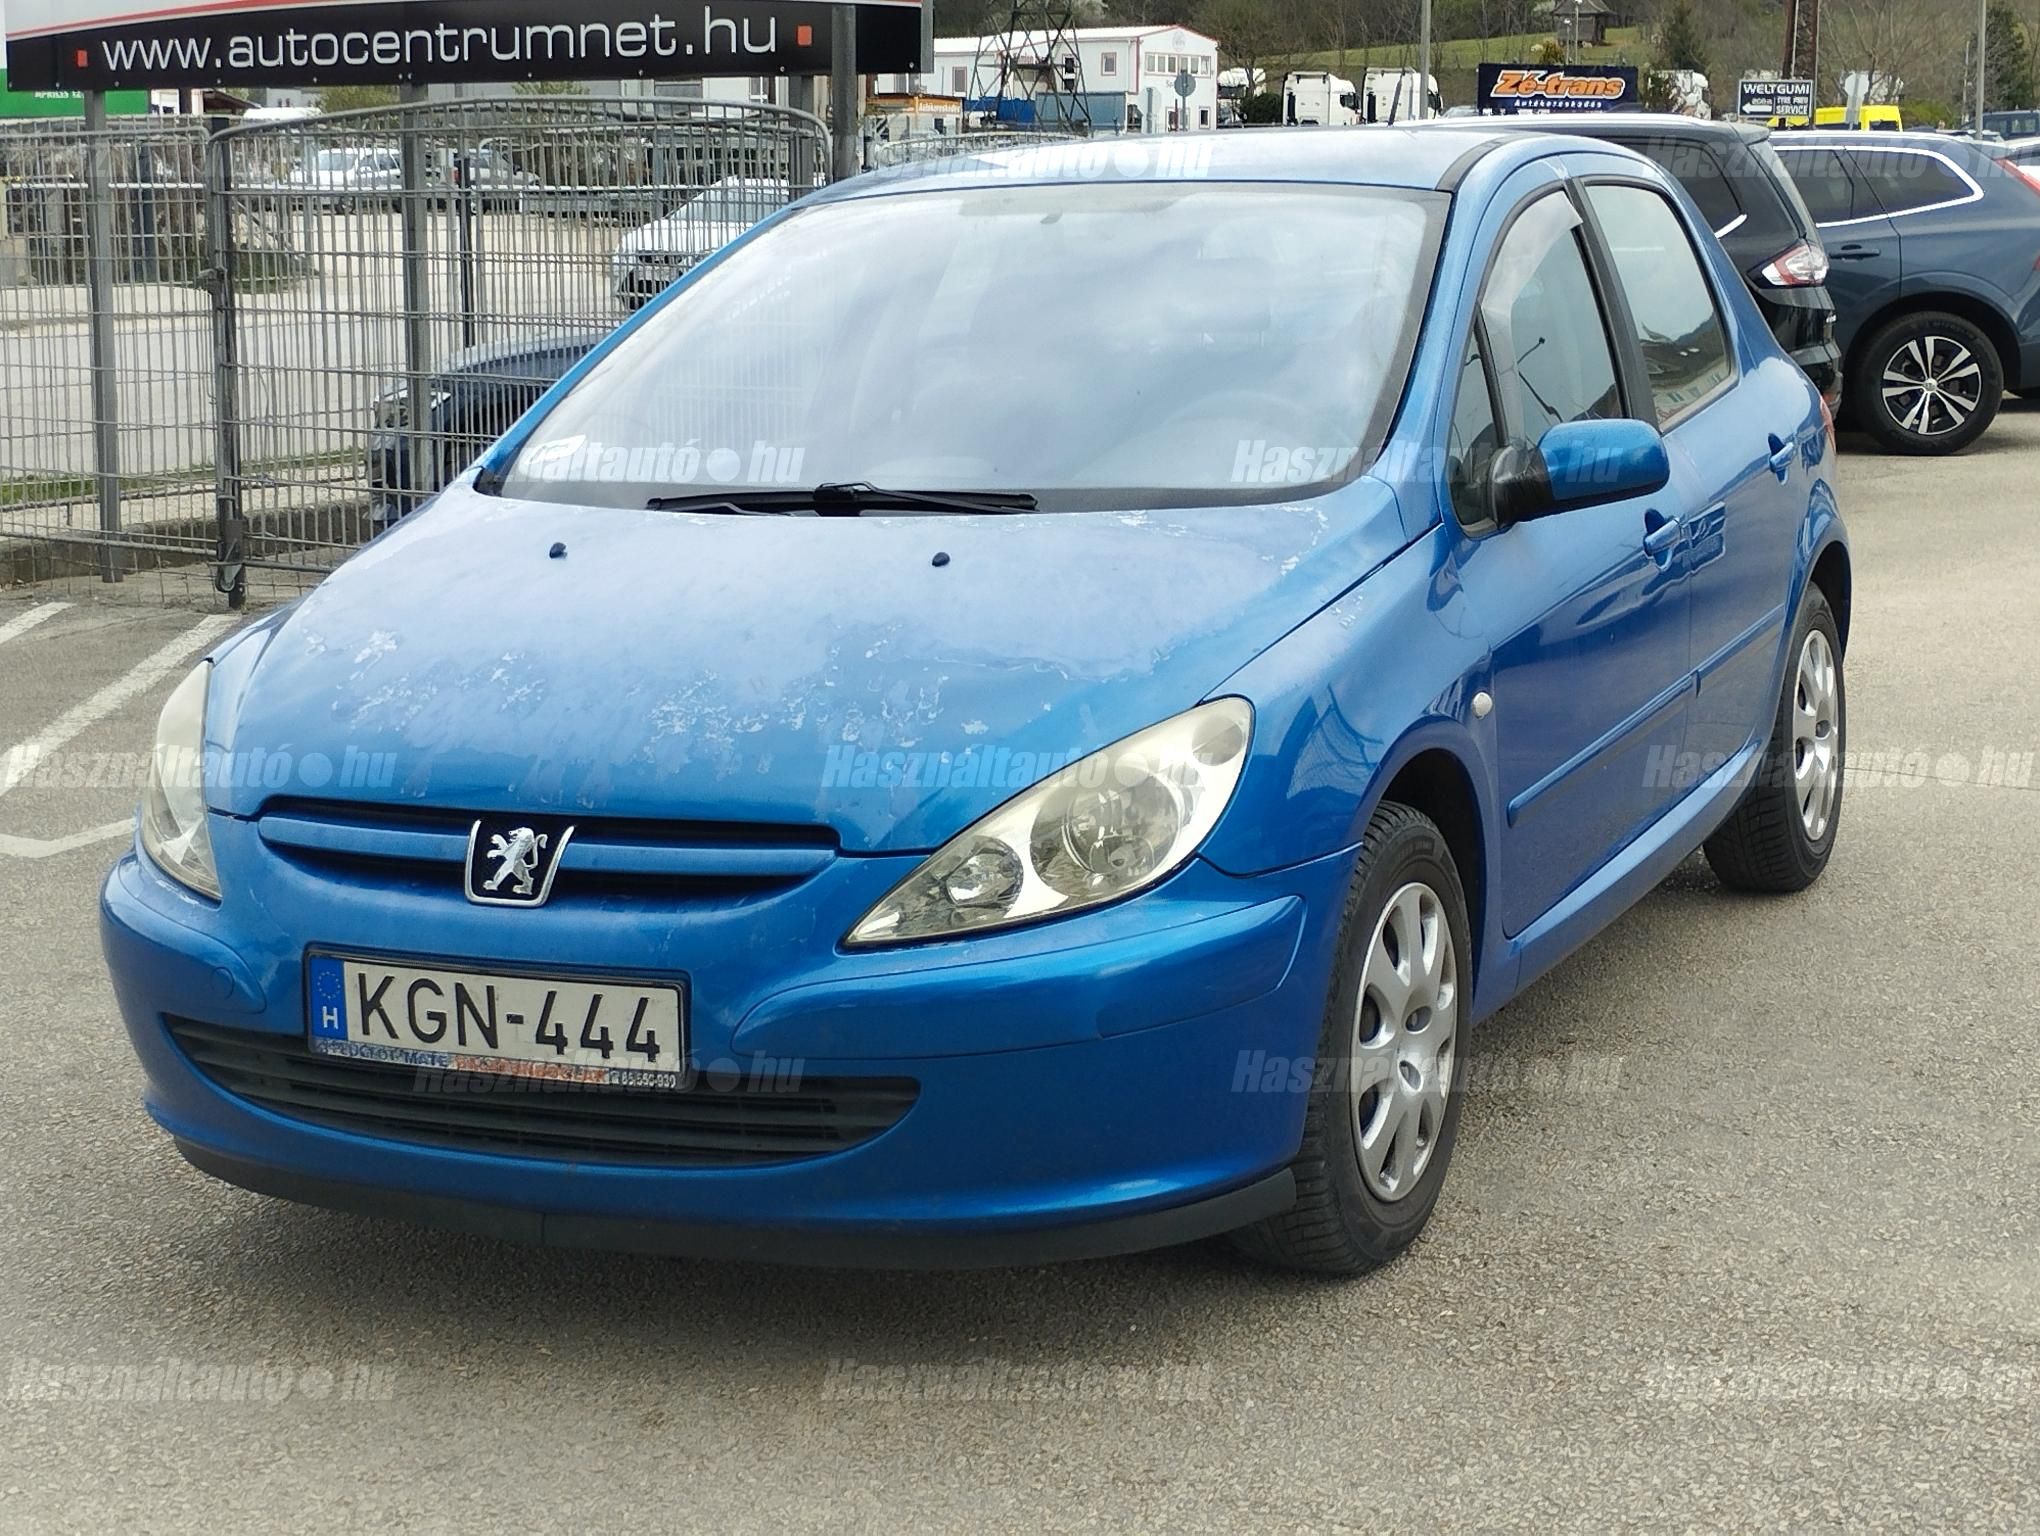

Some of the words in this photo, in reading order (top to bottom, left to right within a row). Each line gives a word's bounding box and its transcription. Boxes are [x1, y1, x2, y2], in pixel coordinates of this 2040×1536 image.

[102, 5, 776, 71] www.autocentrumnet.hu
[322, 1006, 339, 1029] H
[358, 972, 661, 1062] KGN-444
